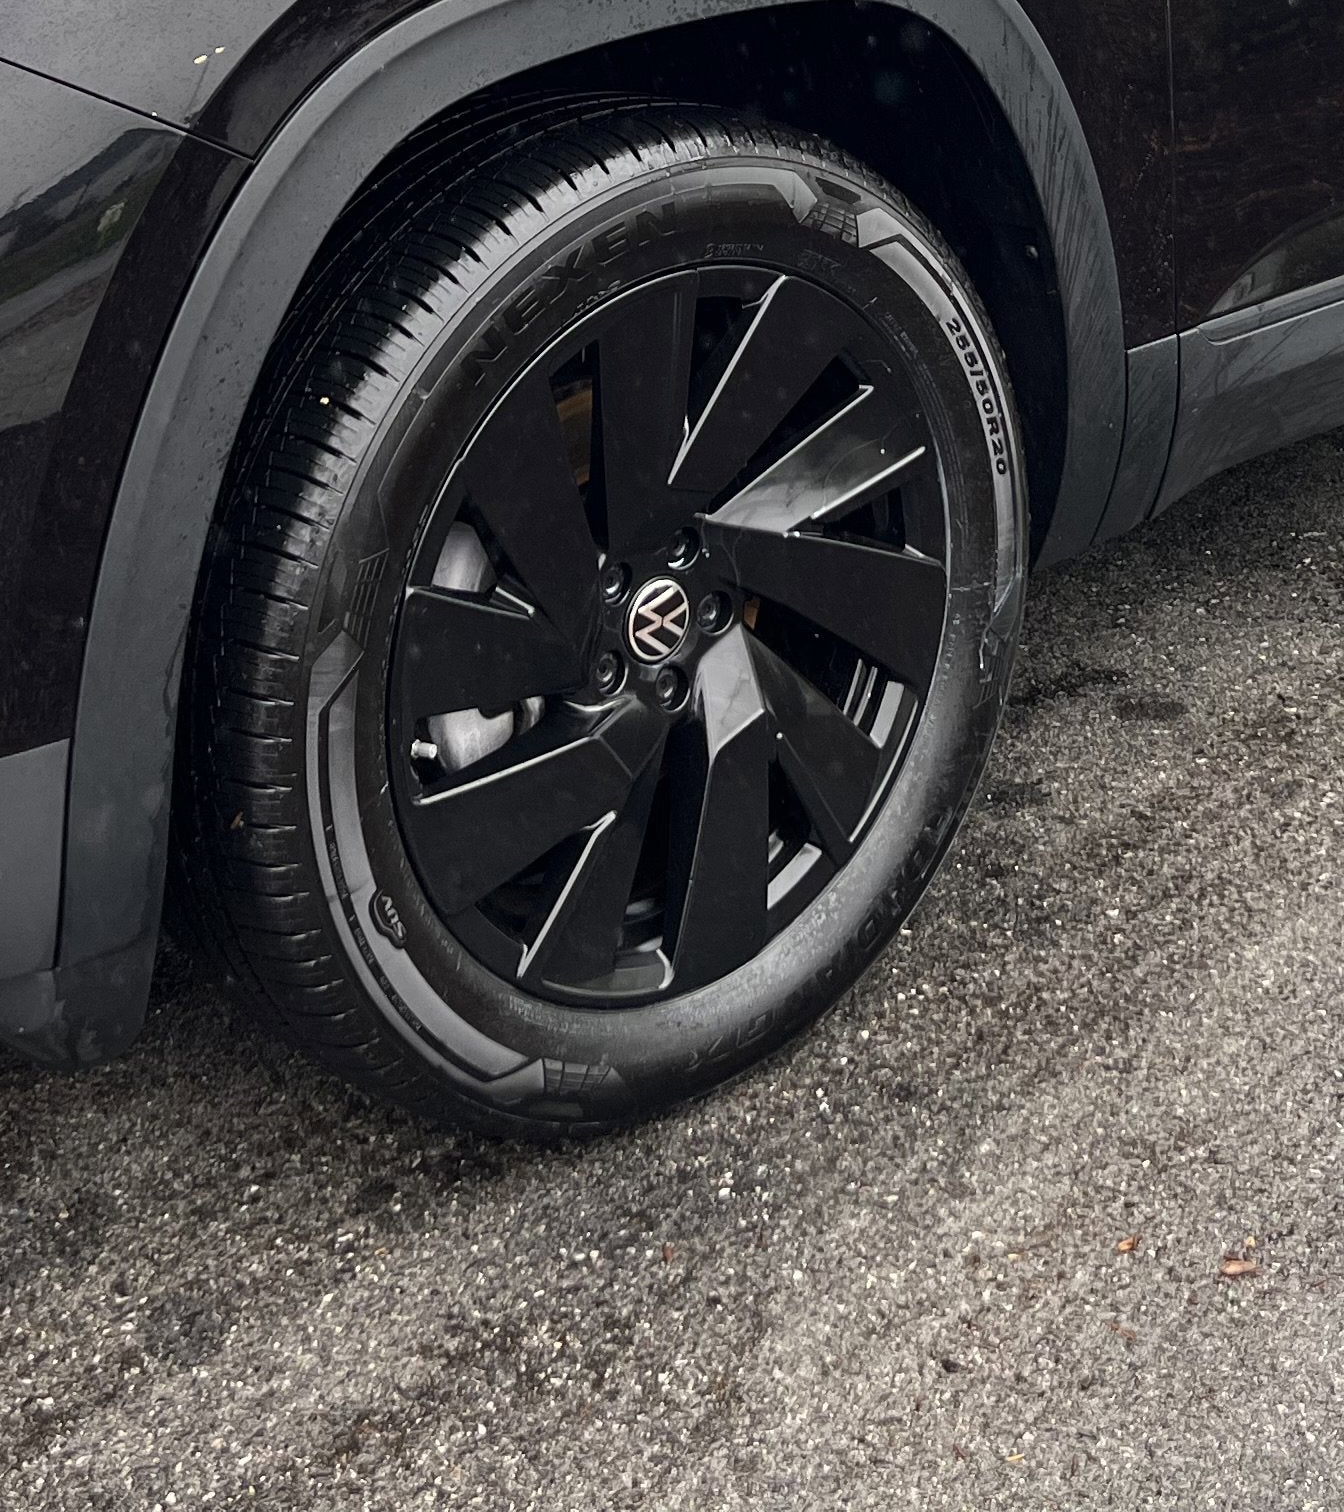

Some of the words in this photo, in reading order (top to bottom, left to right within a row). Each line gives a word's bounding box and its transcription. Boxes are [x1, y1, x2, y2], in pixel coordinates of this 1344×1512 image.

[459, 199, 678, 389] NEXEN
[945, 318, 1007, 475] 255/50R20
[380, 895, 408, 940] SUV
